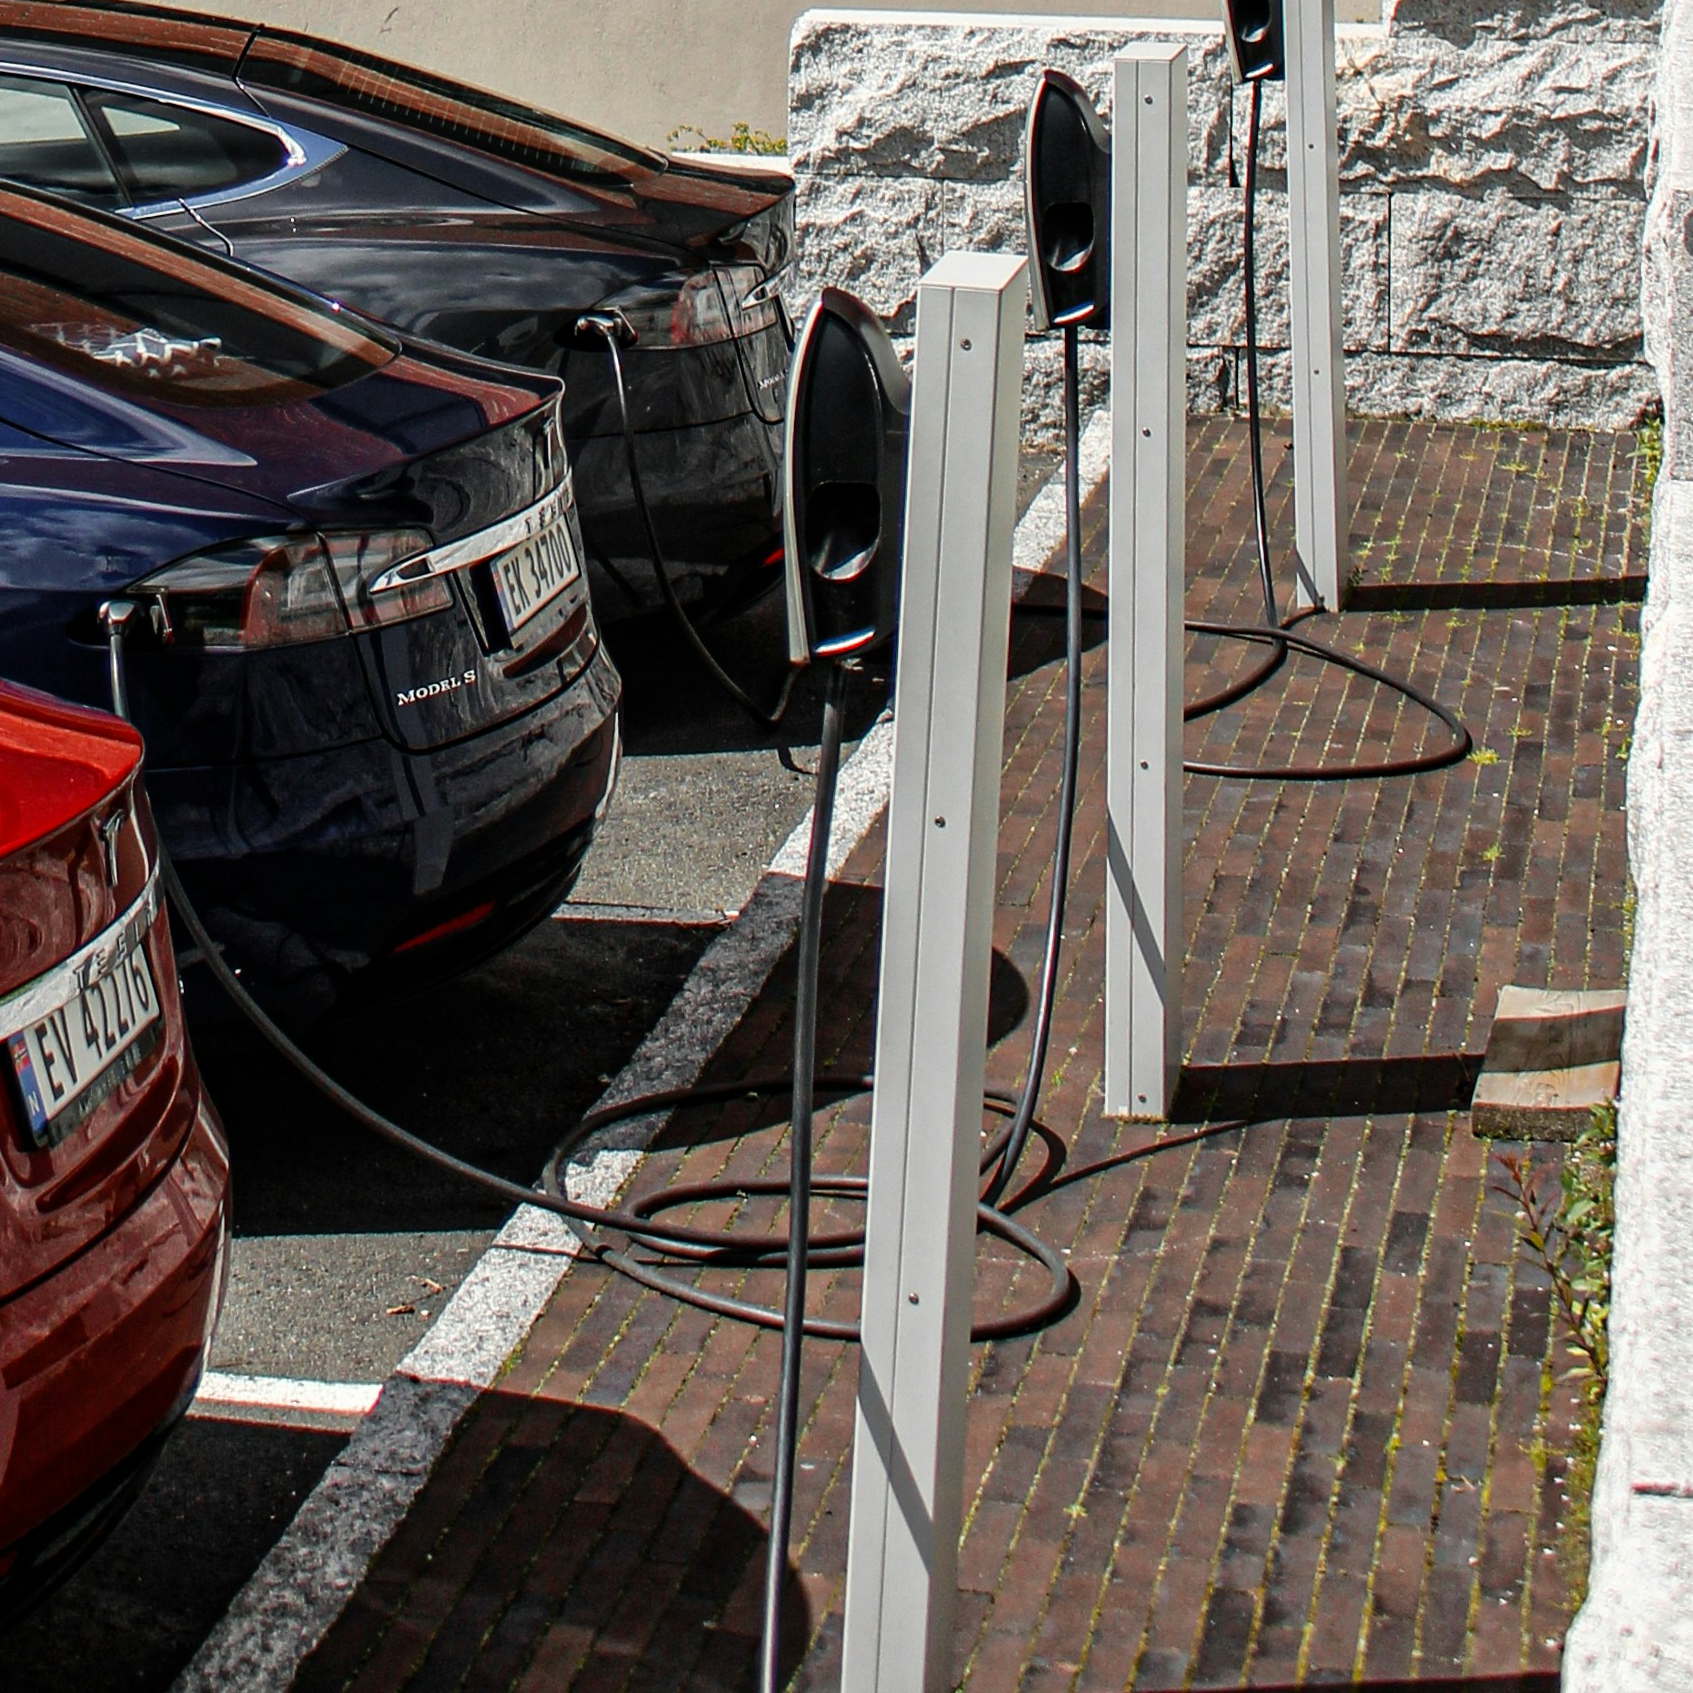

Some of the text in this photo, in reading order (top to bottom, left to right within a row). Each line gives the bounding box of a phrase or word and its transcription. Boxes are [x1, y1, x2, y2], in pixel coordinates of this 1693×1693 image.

[503, 523, 572, 615] EK 34700
[397, 669, 476, 706] MODEL S
[34, 1007, 78, 1102] EV
[80, 953, 150, 1060] 42276
